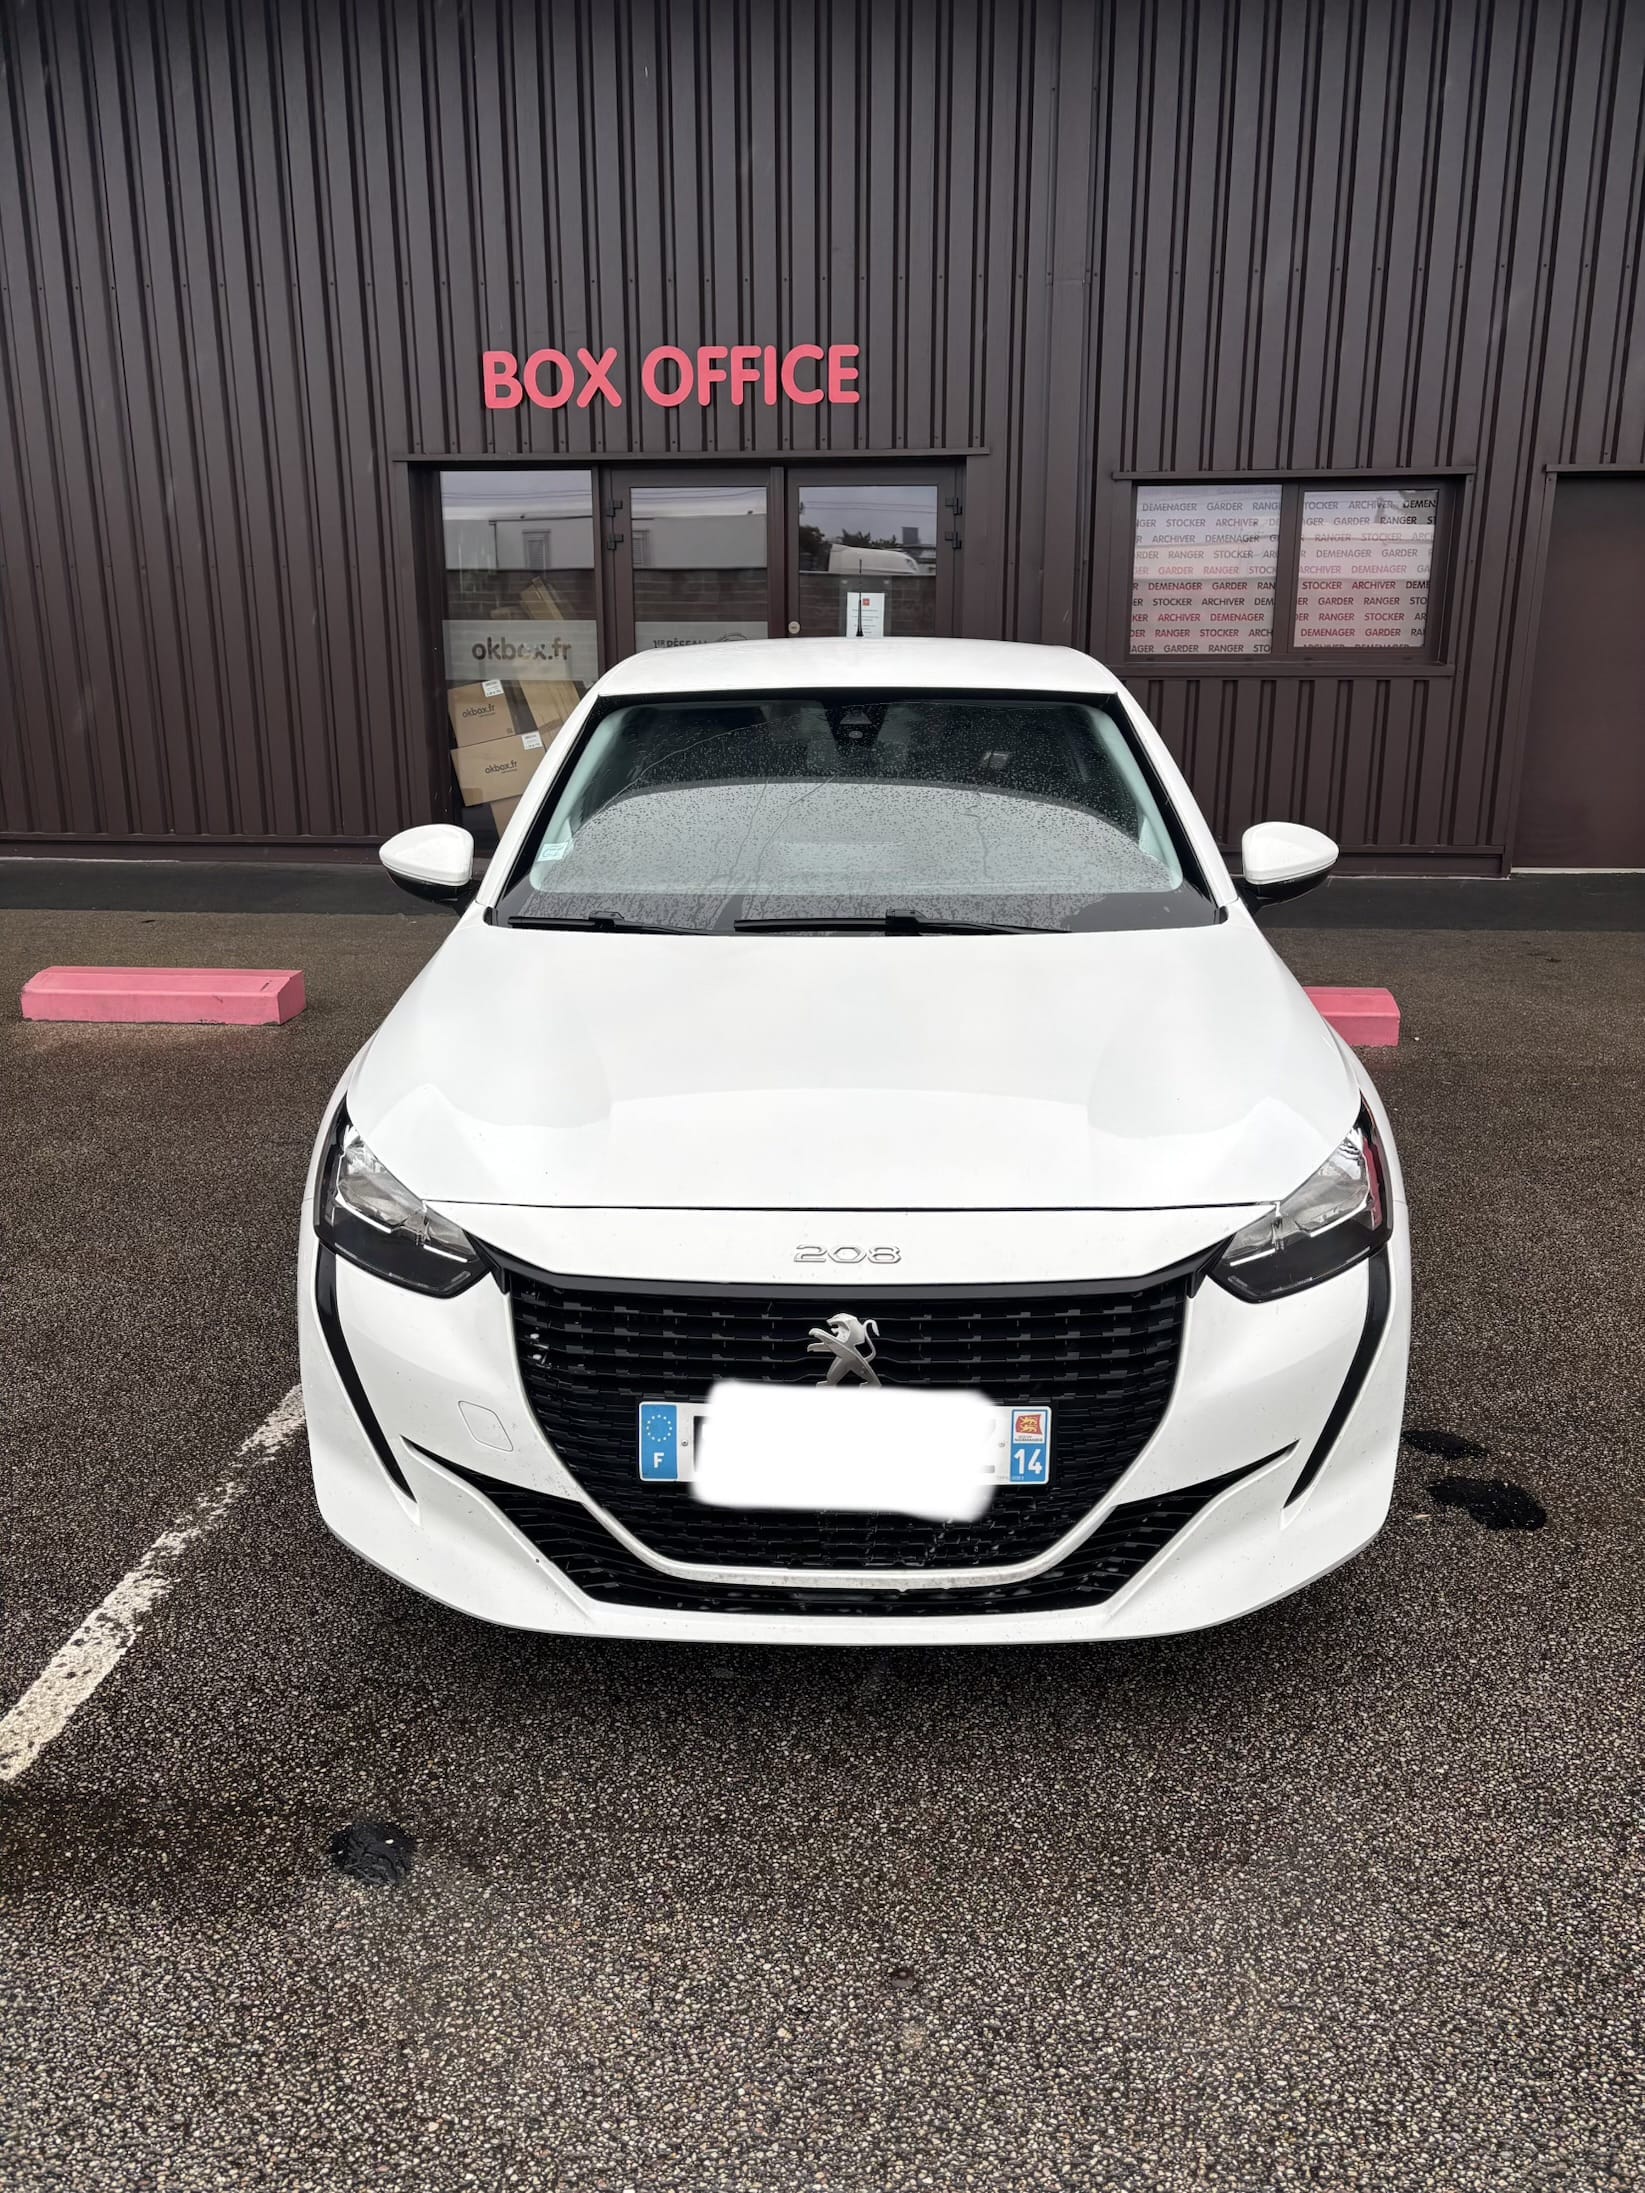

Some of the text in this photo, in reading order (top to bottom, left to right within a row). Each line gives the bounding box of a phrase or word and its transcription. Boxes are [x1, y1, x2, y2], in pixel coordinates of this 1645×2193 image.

[482, 343, 861, 410] BOX OFFICE
[1142, 502, 1280, 512] DEMENAGER GARDER RANG
[1348, 501, 1393, 509] ARCHIVER
[1166, 519, 1206, 527] STOCKER
[1216, 518, 1259, 527] ARCHIVER
[1333, 517, 1370, 526] GARDER
[1380, 516, 1417, 525] RANGER
[1152, 535, 1195, 543] ARCHIVER
[1205, 535, 1259, 543] DEMENAGER
[1314, 533, 1351, 542] RANGER
[1168, 551, 1204, 559] RANGER
[1214, 550, 1253, 559] STOCKER
[1316, 550, 1372, 558] DEMENAGER
[1382, 549, 1418, 557] GARDER
[1158, 566, 1194, 575] GARDER
[1203, 566, 1239, 575] RANGER
[1351, 565, 1407, 574] DEMENAGER
[1148, 582, 1202, 591] DEMENAGER
[1212, 582, 1248, 590] GARDER
[1302, 581, 1342, 590] STOCKER
[1352, 581, 1396, 589] ARCHIVER
[1153, 598, 1192, 606] STOCKER
[1202, 598, 1245, 606] ARCHIVER
[1318, 597, 1354, 605] GARDER
[1364, 597, 1400, 605] RANGER
[1158, 613, 1201, 622] ARCHIVER
[1210, 613, 1264, 622] DEMENAGER
[1319, 613, 1355, 621] RANGER
[1364, 613, 1405, 621] STOCKER
[1155, 629, 1190, 638] RANGER
[1200, 629, 1239, 637] STOCKER
[1301, 628, 1355, 637] DEMENAGER
[1365, 628, 1401, 637] GARDER
[472, 637, 572, 661] okbox.fr
[1164, 645, 1199, 653] GARDER
[1208, 644, 1244, 653] RANGER
[462, 704, 496, 718] okbox.fr
[484, 760, 518, 774] okbox.fr
[793, 1243, 902, 1265] 208
[654, 1452, 665, 1468] F
[1014, 1448, 1043, 1474] 14
